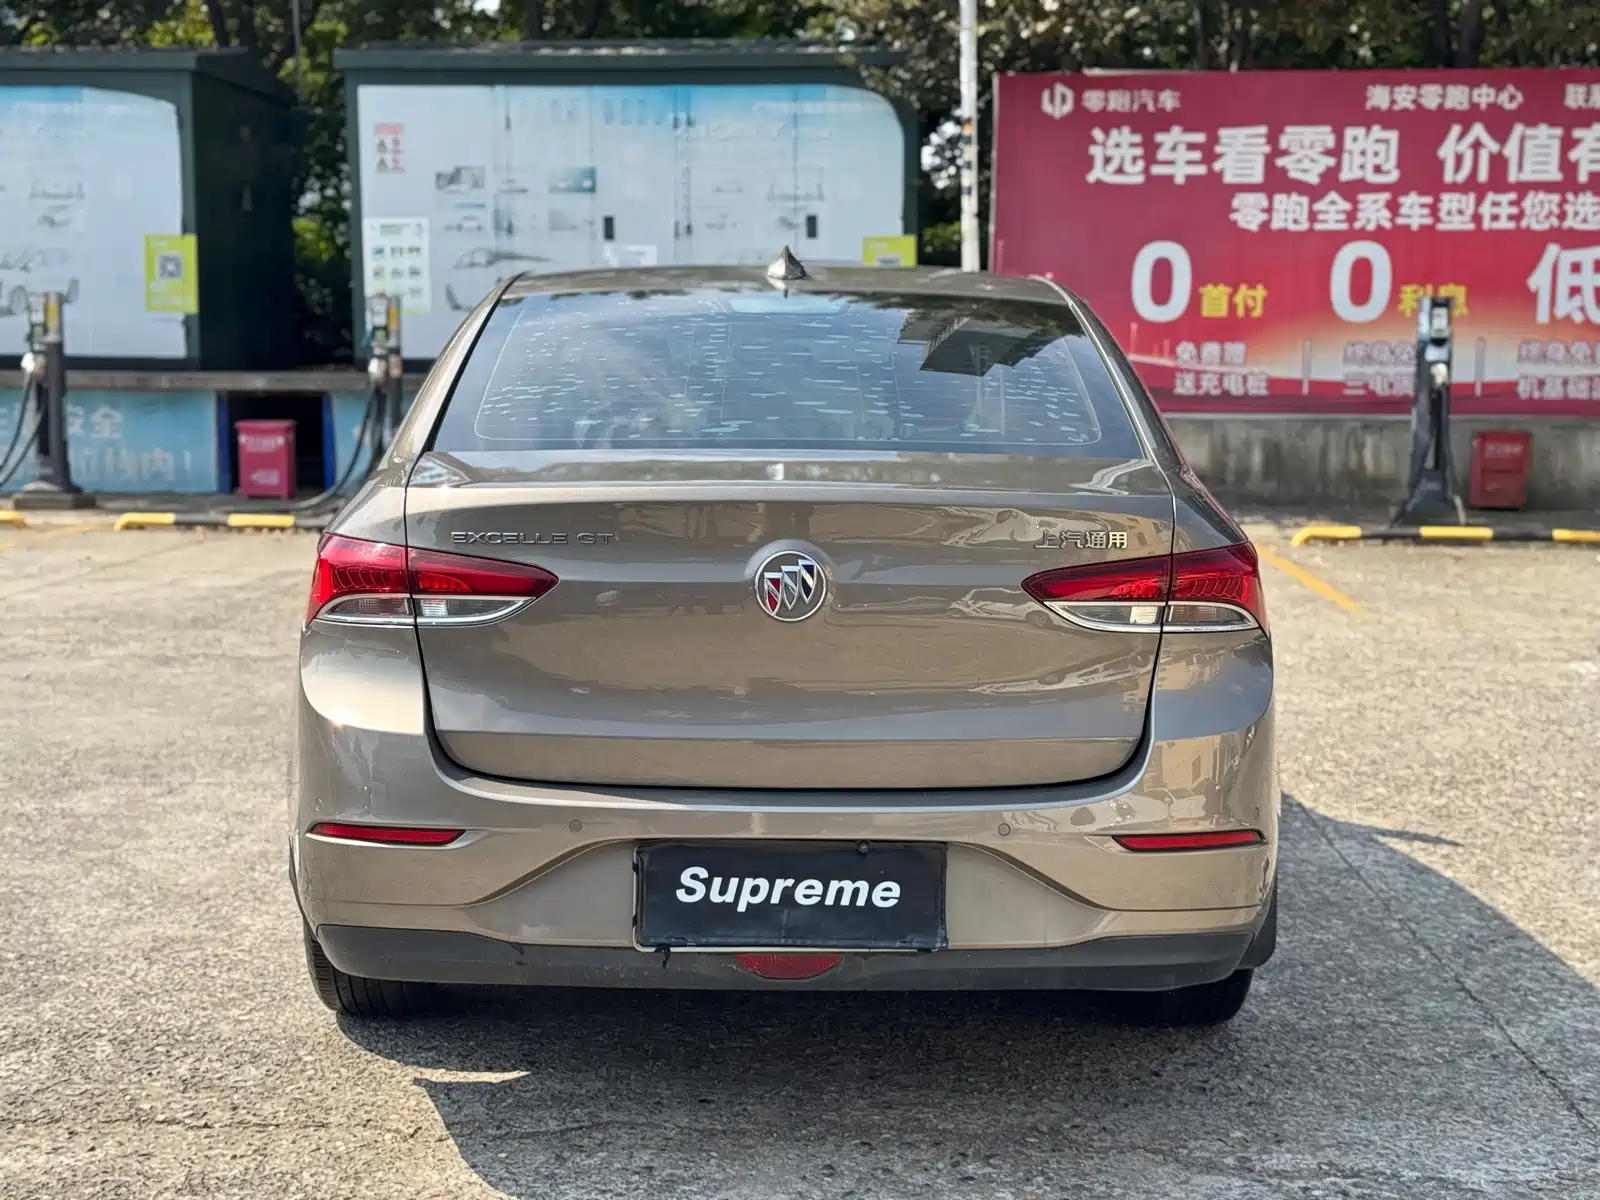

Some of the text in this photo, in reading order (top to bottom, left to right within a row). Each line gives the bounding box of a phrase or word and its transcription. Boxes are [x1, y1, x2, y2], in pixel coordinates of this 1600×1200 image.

[1082, 89, 1181, 112] 零跑汽车
[1365, 84, 1524, 110] 海安零跑中心
[1085, 125, 1400, 184] 选车看零跑
[1229, 190, 1600, 232] 零跑全系车型任您选
[1131, 240, 1268, 323] 0 首付
[1330, 240, 1392, 323] 0
[451, 531, 613, 545] EXCELLE GT
[1034, 529, 1128, 549] 上汽通用
[676, 866, 901, 913] Supreme
